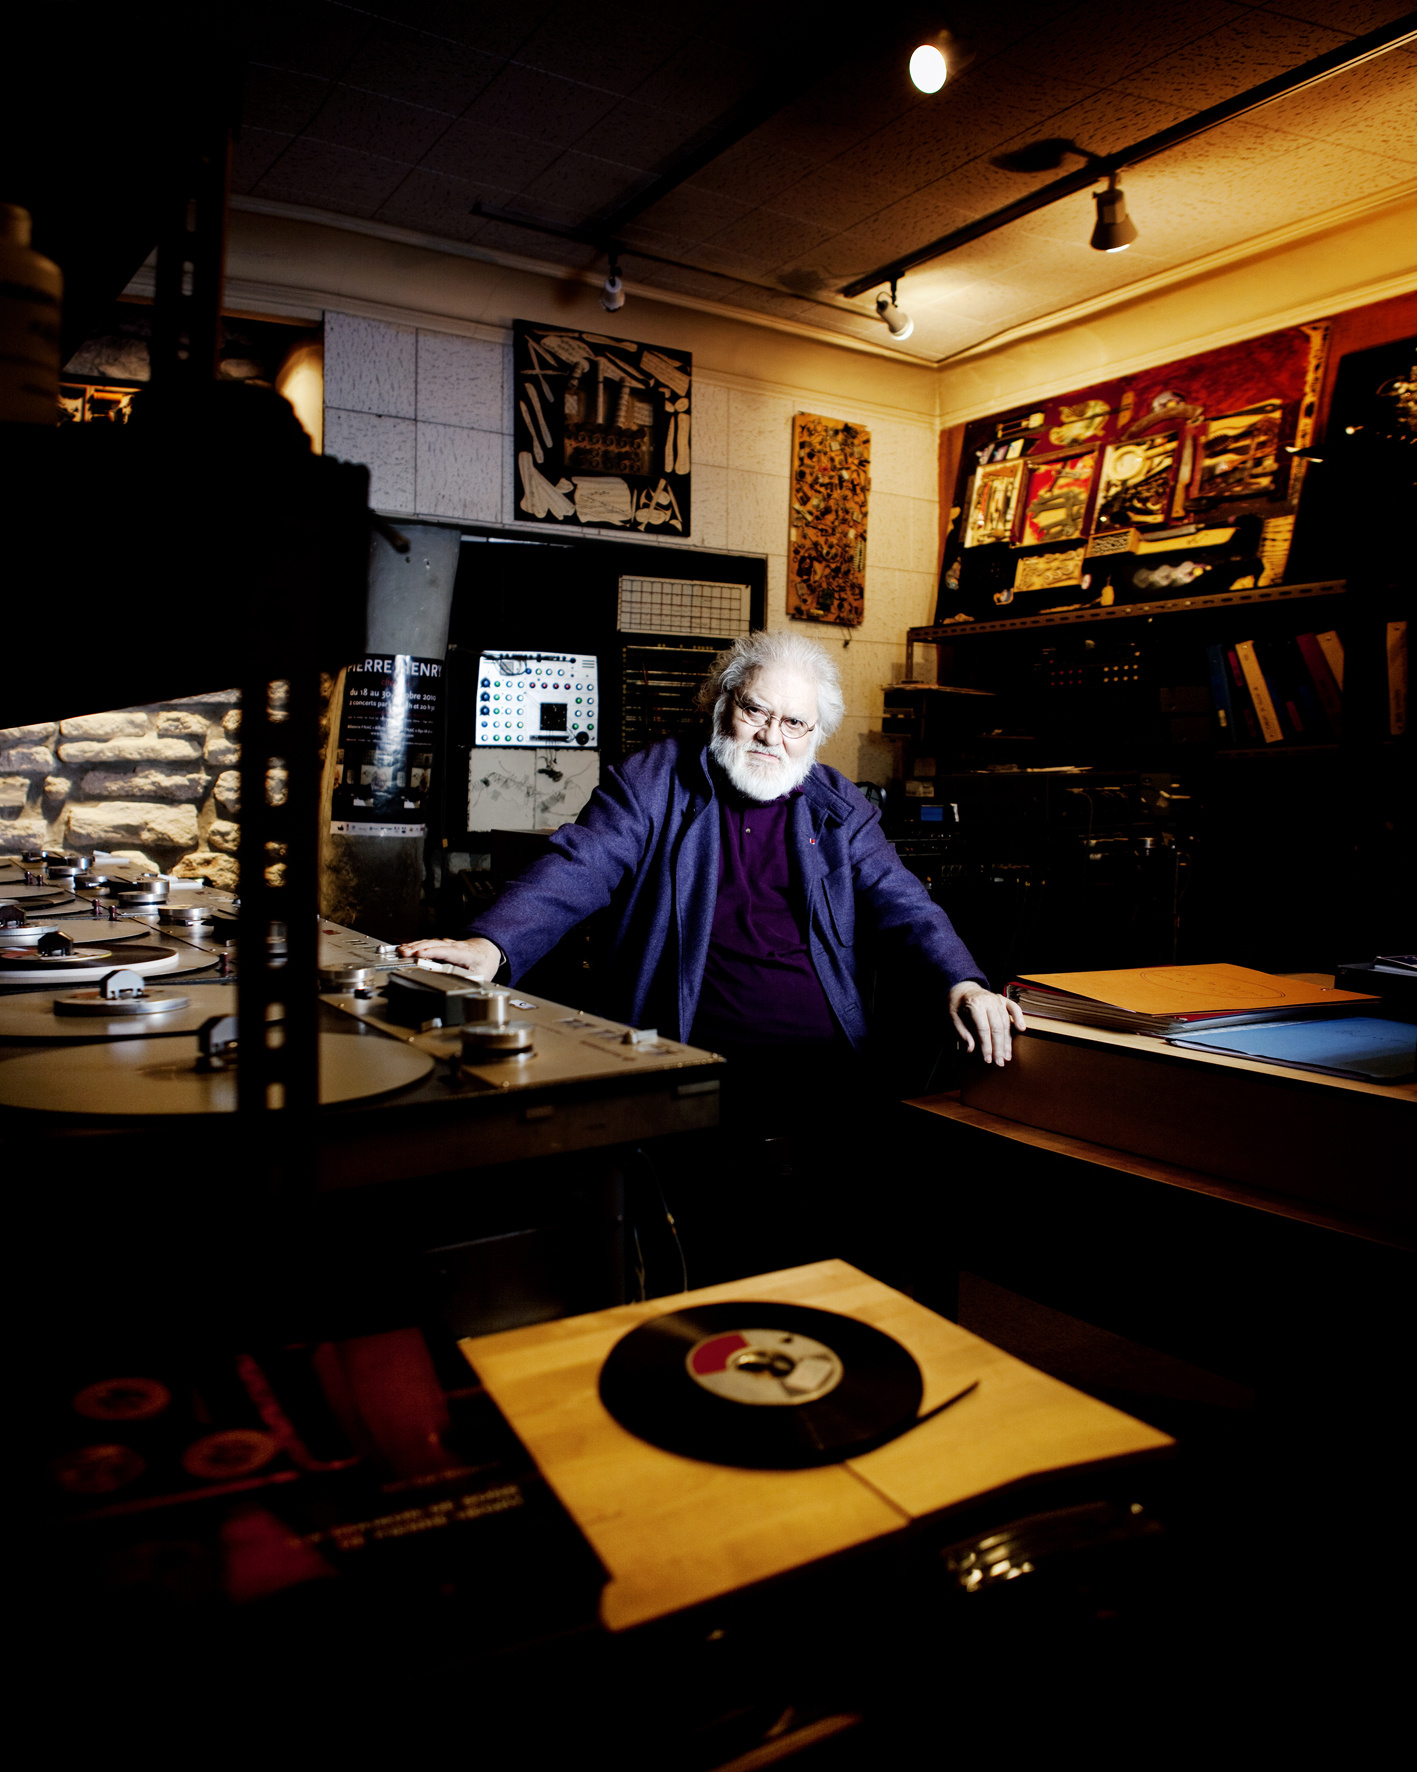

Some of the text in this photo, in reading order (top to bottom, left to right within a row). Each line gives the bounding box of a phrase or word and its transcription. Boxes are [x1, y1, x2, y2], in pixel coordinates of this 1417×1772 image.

[350, 688, 358, 696] du
[360, 688, 368, 696] 18
[381, 691, 391, 699] 30
